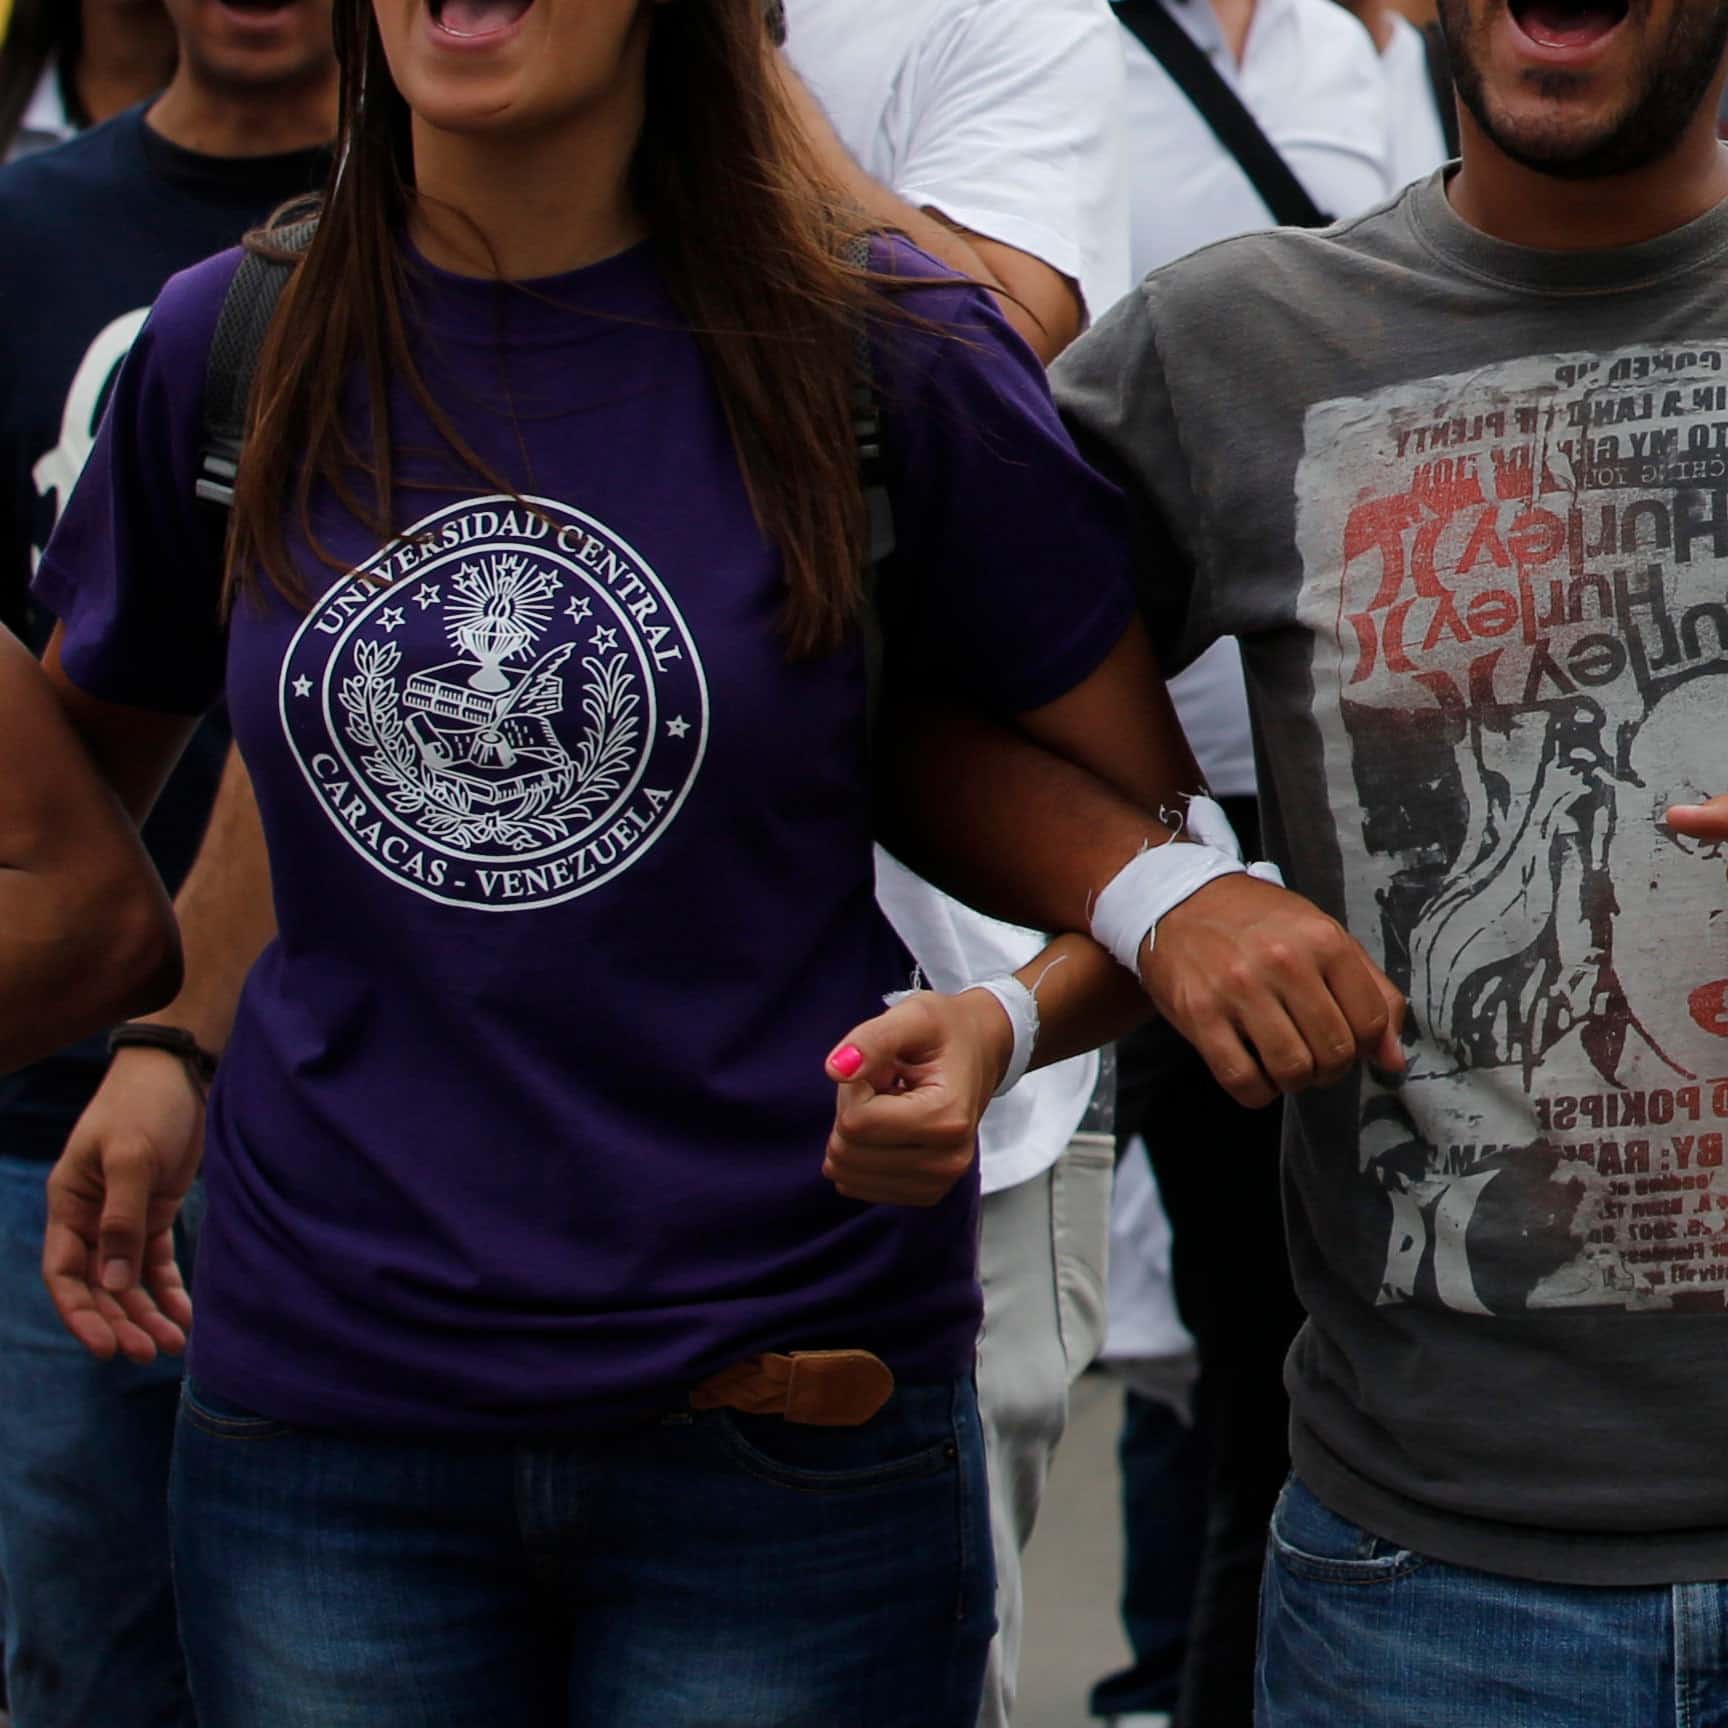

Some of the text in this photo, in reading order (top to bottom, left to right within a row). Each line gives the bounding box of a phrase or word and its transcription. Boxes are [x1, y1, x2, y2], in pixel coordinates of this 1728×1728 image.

[314, 510, 684, 674] UNIVERSIDAD CENTRAL
[1420, 564, 1665, 651] Hurley
[310, 752, 449, 887] CARACAS
[474, 785, 674, 899] VENEZUELA
